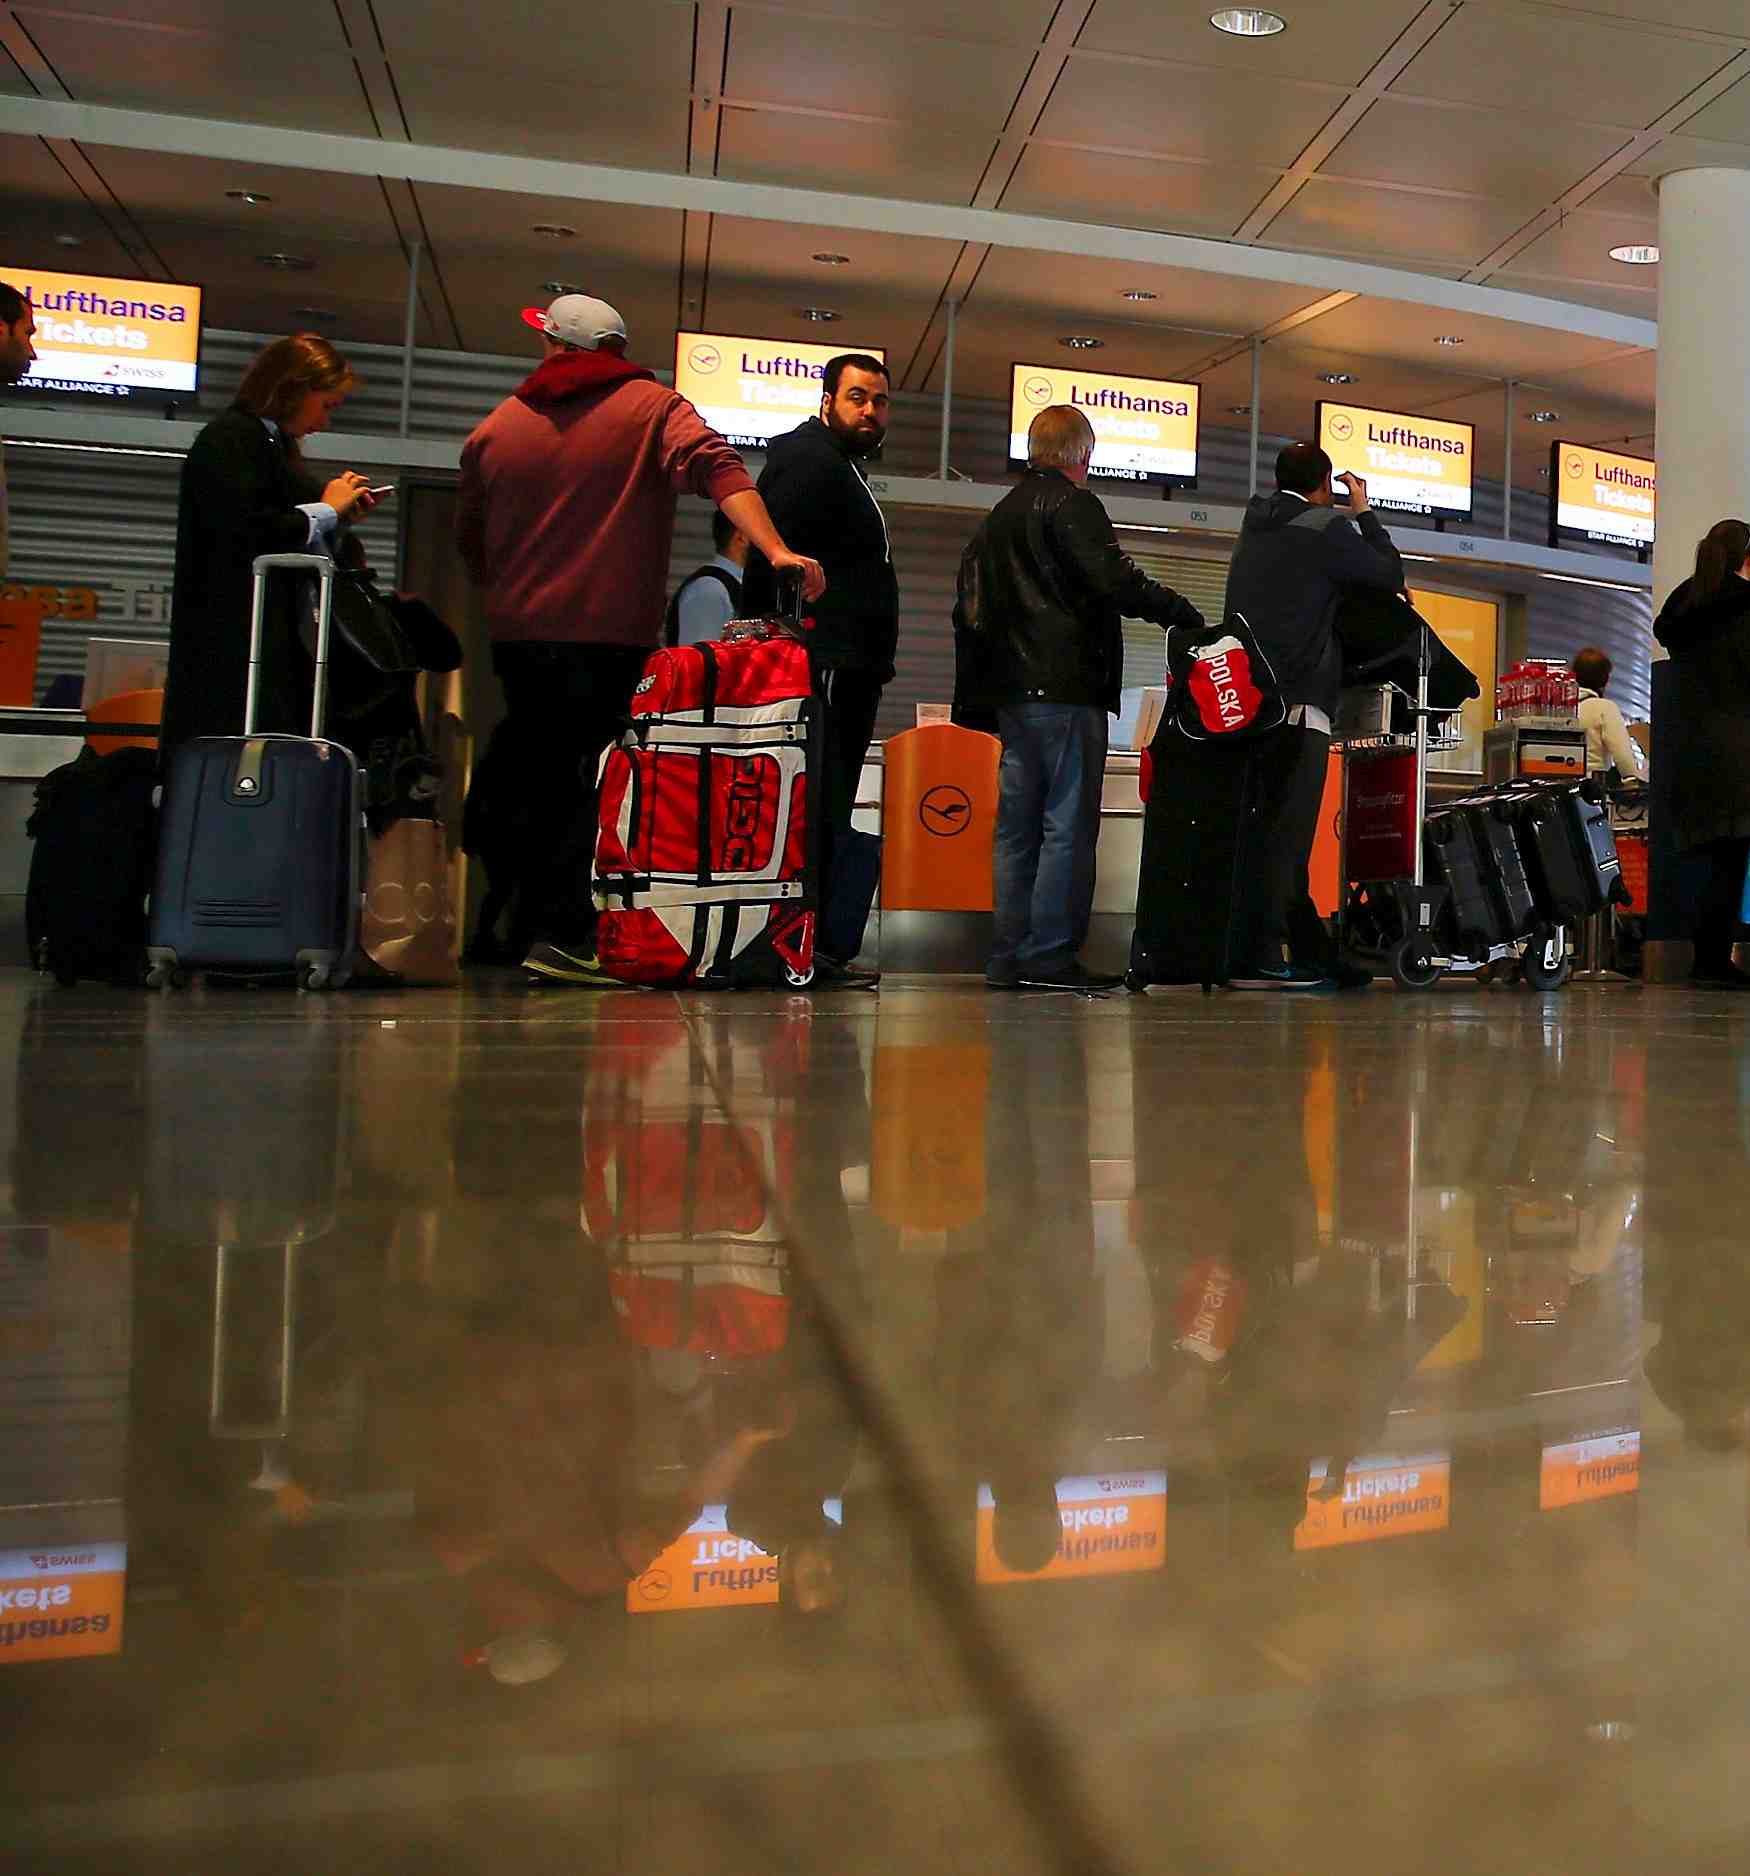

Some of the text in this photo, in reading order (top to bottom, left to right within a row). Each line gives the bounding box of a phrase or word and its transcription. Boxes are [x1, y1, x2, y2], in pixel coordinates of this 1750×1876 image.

[25, 286, 186, 322] Lufthansa
[741, 353, 826, 379] Luftha
[45, 380, 115, 394] ALLIANCE
[1071, 385, 1188, 416] Lufthansa
[727, 436, 757, 446] STAR
[1368, 423, 1465, 455] Lufthansa
[1087, 466, 1136, 480] ALLIANCE
[1382, 500, 1423, 513] ALLIANCE
[1206, 654, 1245, 728] POLSKA
